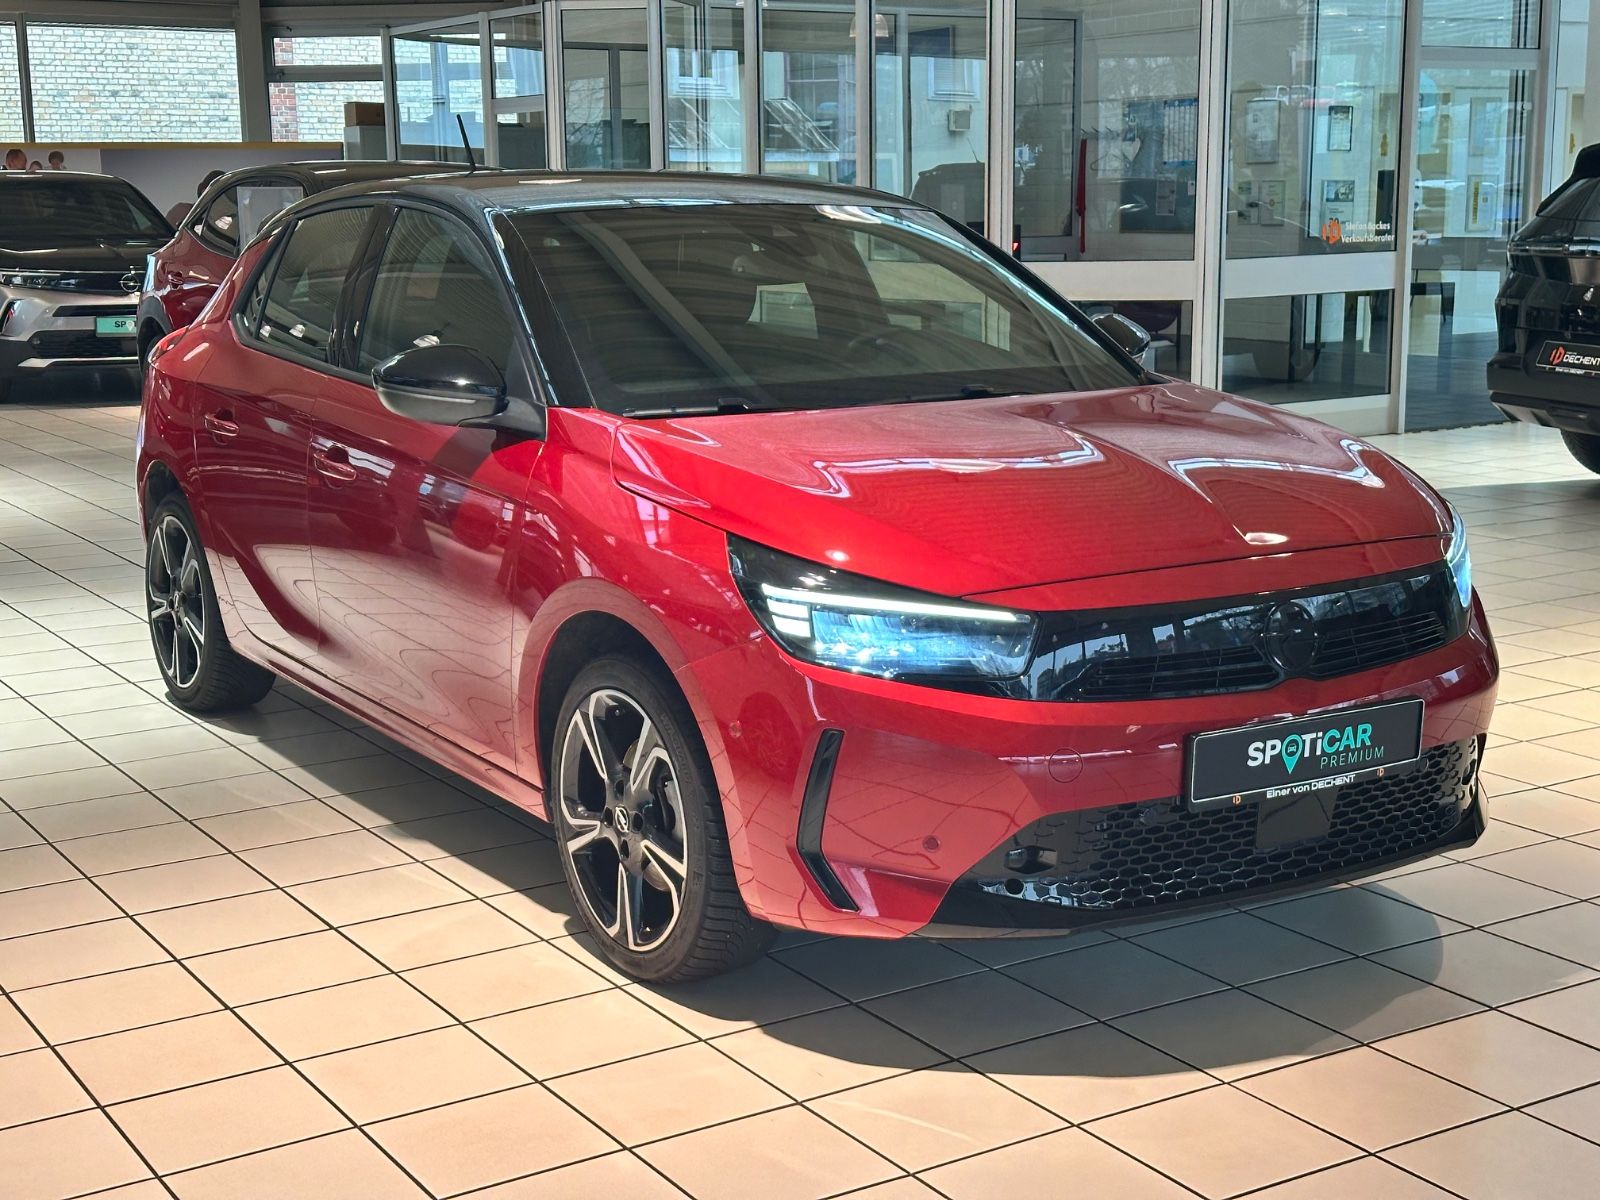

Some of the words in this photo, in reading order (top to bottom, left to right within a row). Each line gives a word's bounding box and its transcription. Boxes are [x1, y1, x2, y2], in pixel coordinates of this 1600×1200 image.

[1341, 234, 1395, 243] Verkaufsberater
[1562, 354, 1600, 366] DECHENT
[1320, 745, 1385, 769] PREMIUM
[1266, 787, 1291, 799] Einer
[1292, 784, 1310, 794] von
[1311, 774, 1356, 791] DECHENT
